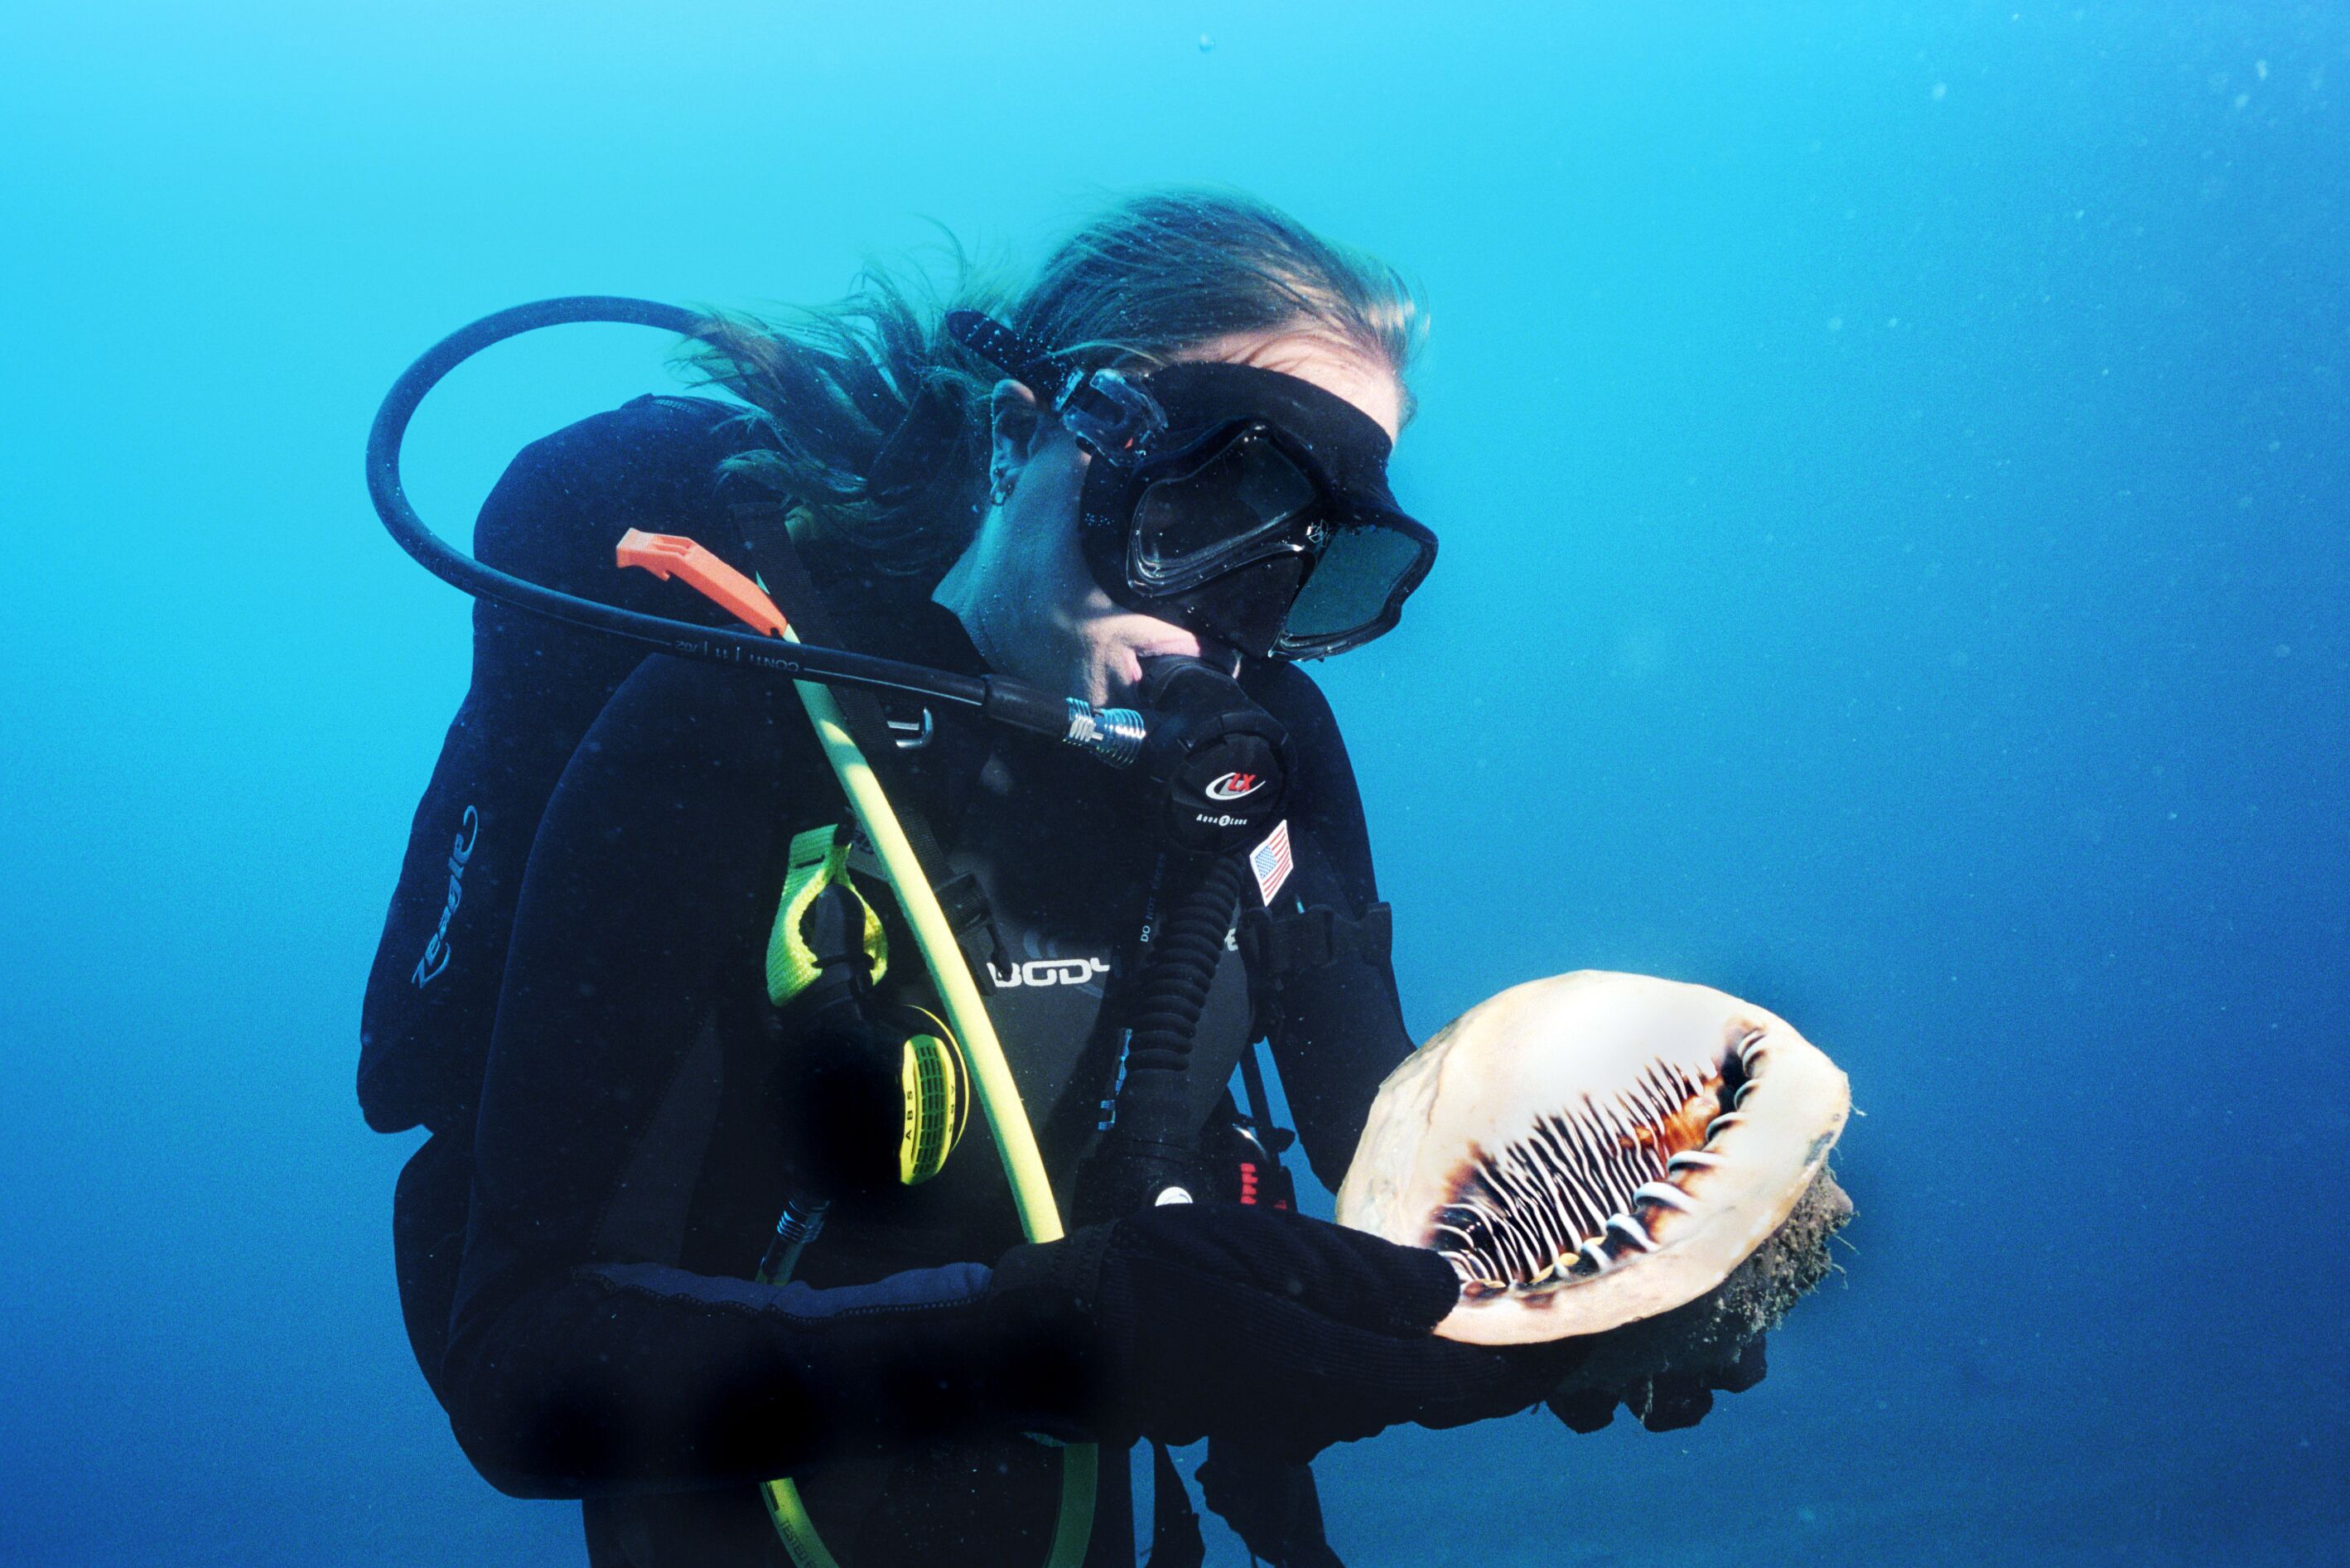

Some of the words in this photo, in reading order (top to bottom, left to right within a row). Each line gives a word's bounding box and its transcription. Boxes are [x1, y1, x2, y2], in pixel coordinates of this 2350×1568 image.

[749, 654, 799, 673] CONTI
[1228, 771, 1257, 793] LX
[412, 804, 479, 990] Zeagle
[1145, 895, 1158, 922] NOT
[1140, 924, 1152, 943] DO
[905, 1089, 914, 1141] ABS
[782, 1517, 808, 1561] TESTED
